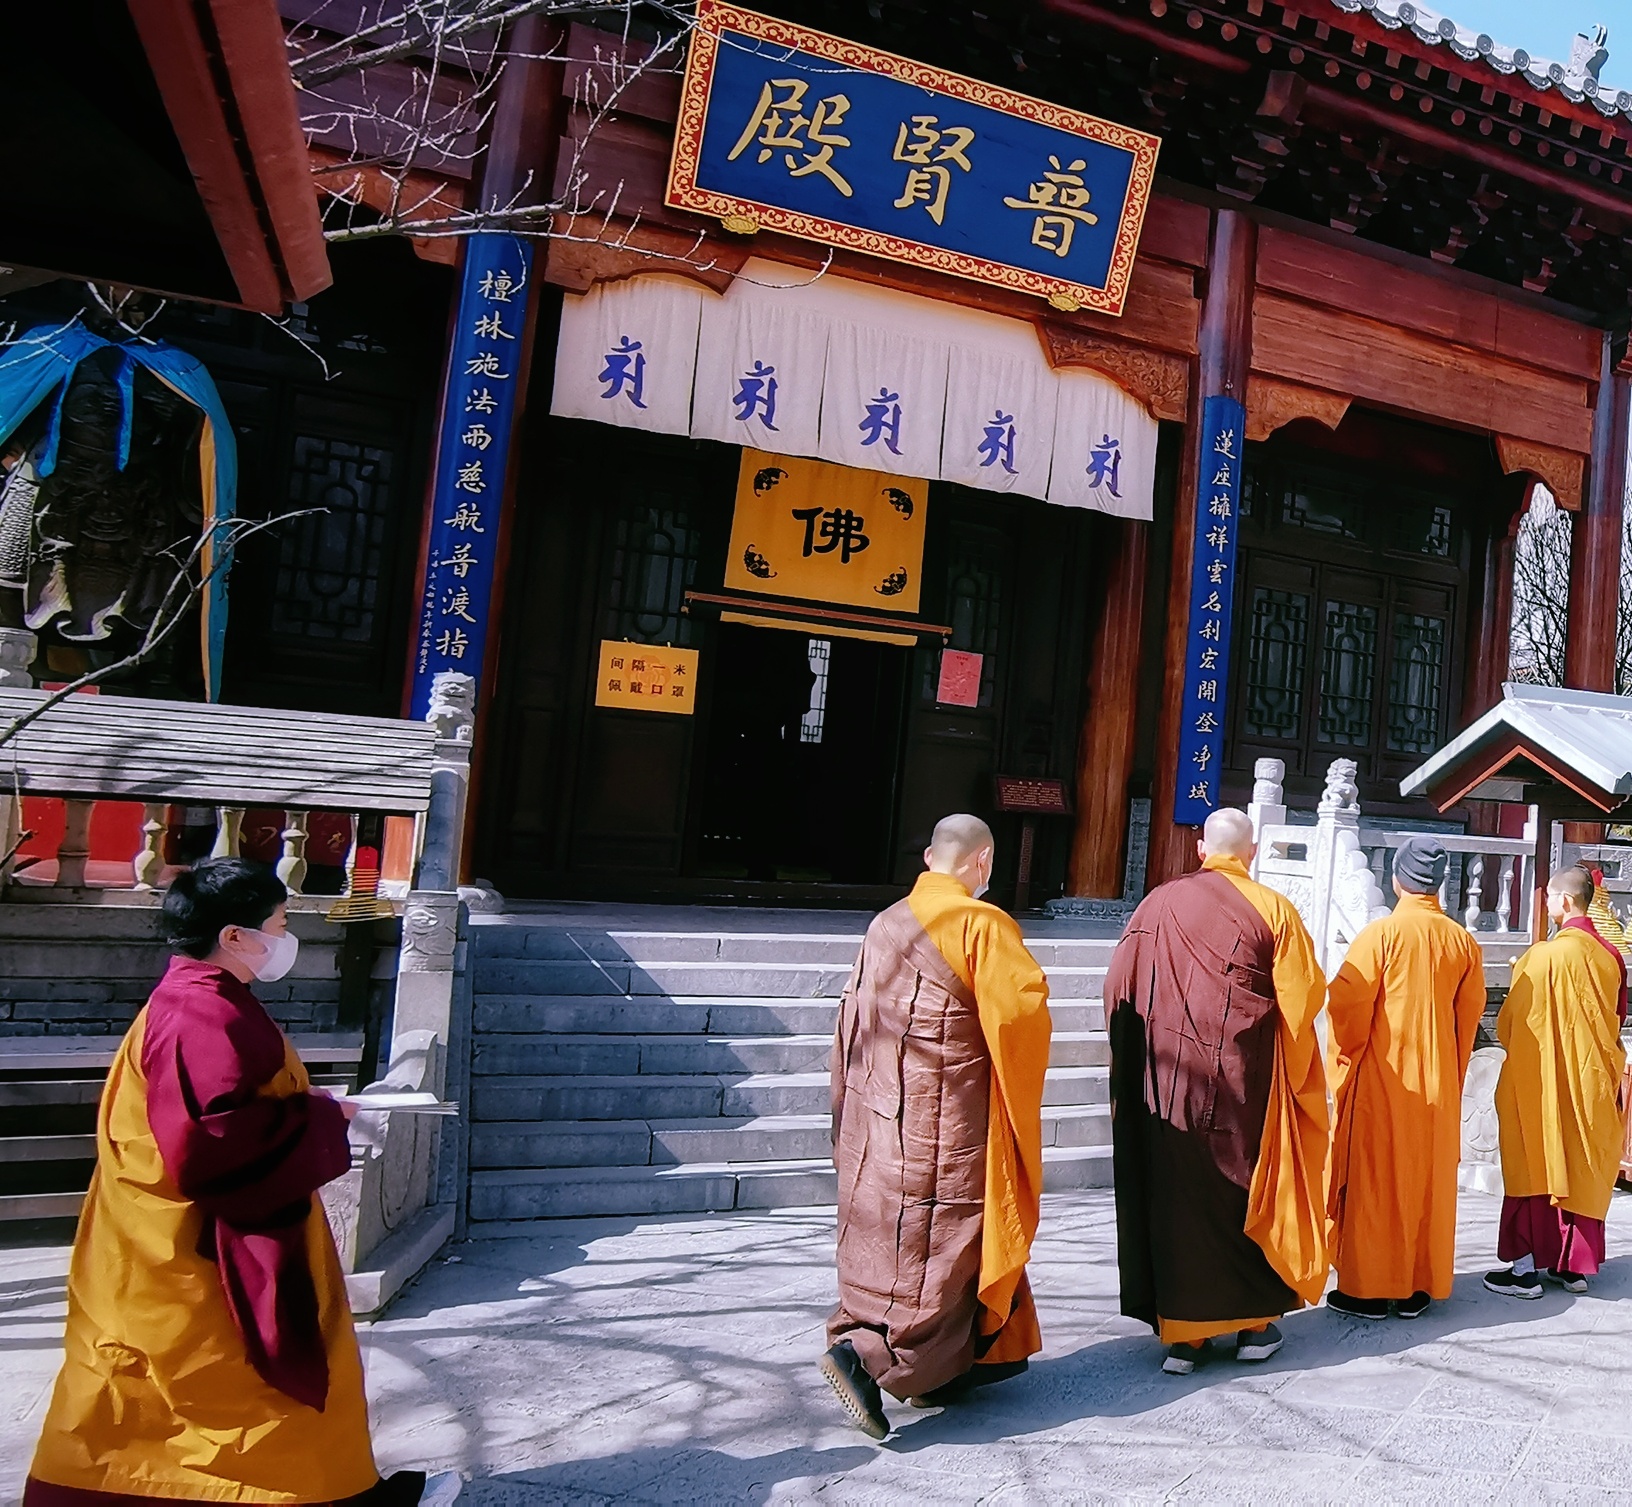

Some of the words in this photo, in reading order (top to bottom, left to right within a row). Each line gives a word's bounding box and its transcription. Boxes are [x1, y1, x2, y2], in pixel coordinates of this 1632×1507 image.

[792, 506, 869, 565] 佛
[610, 656, 687, 676] 间隔一米
[608, 679, 685, 698] 佩戴口罩
